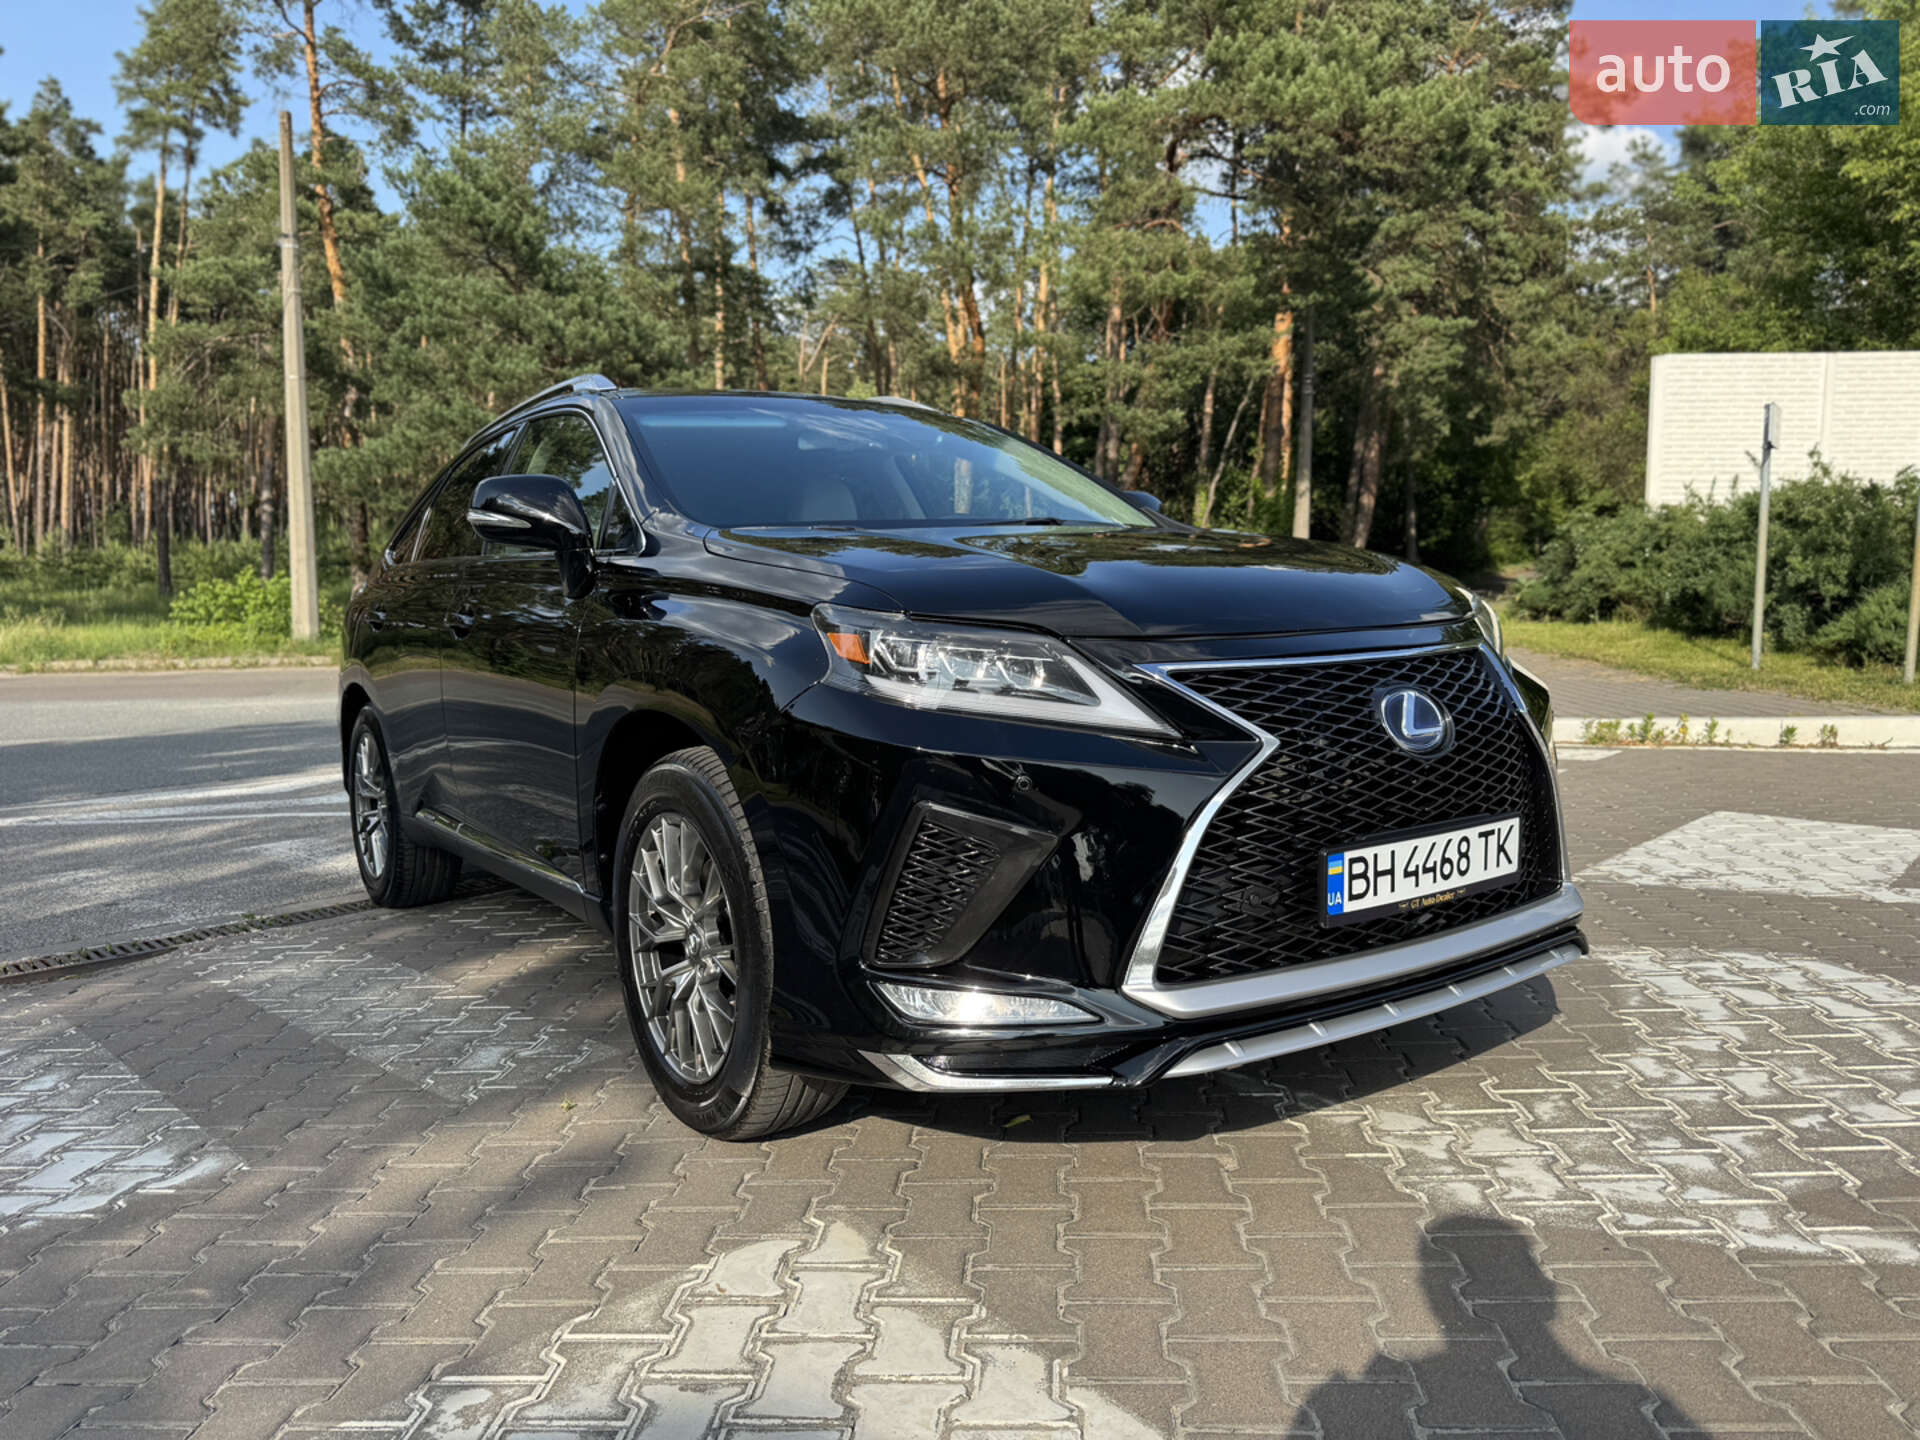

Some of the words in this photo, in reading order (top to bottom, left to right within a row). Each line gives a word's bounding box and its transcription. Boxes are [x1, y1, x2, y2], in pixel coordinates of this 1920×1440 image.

[1347, 849, 1396, 902] BH
[1403, 835, 1471, 888] 4468
[1478, 824, 1515, 871] TK
[1327, 891, 1343, 906] UA
